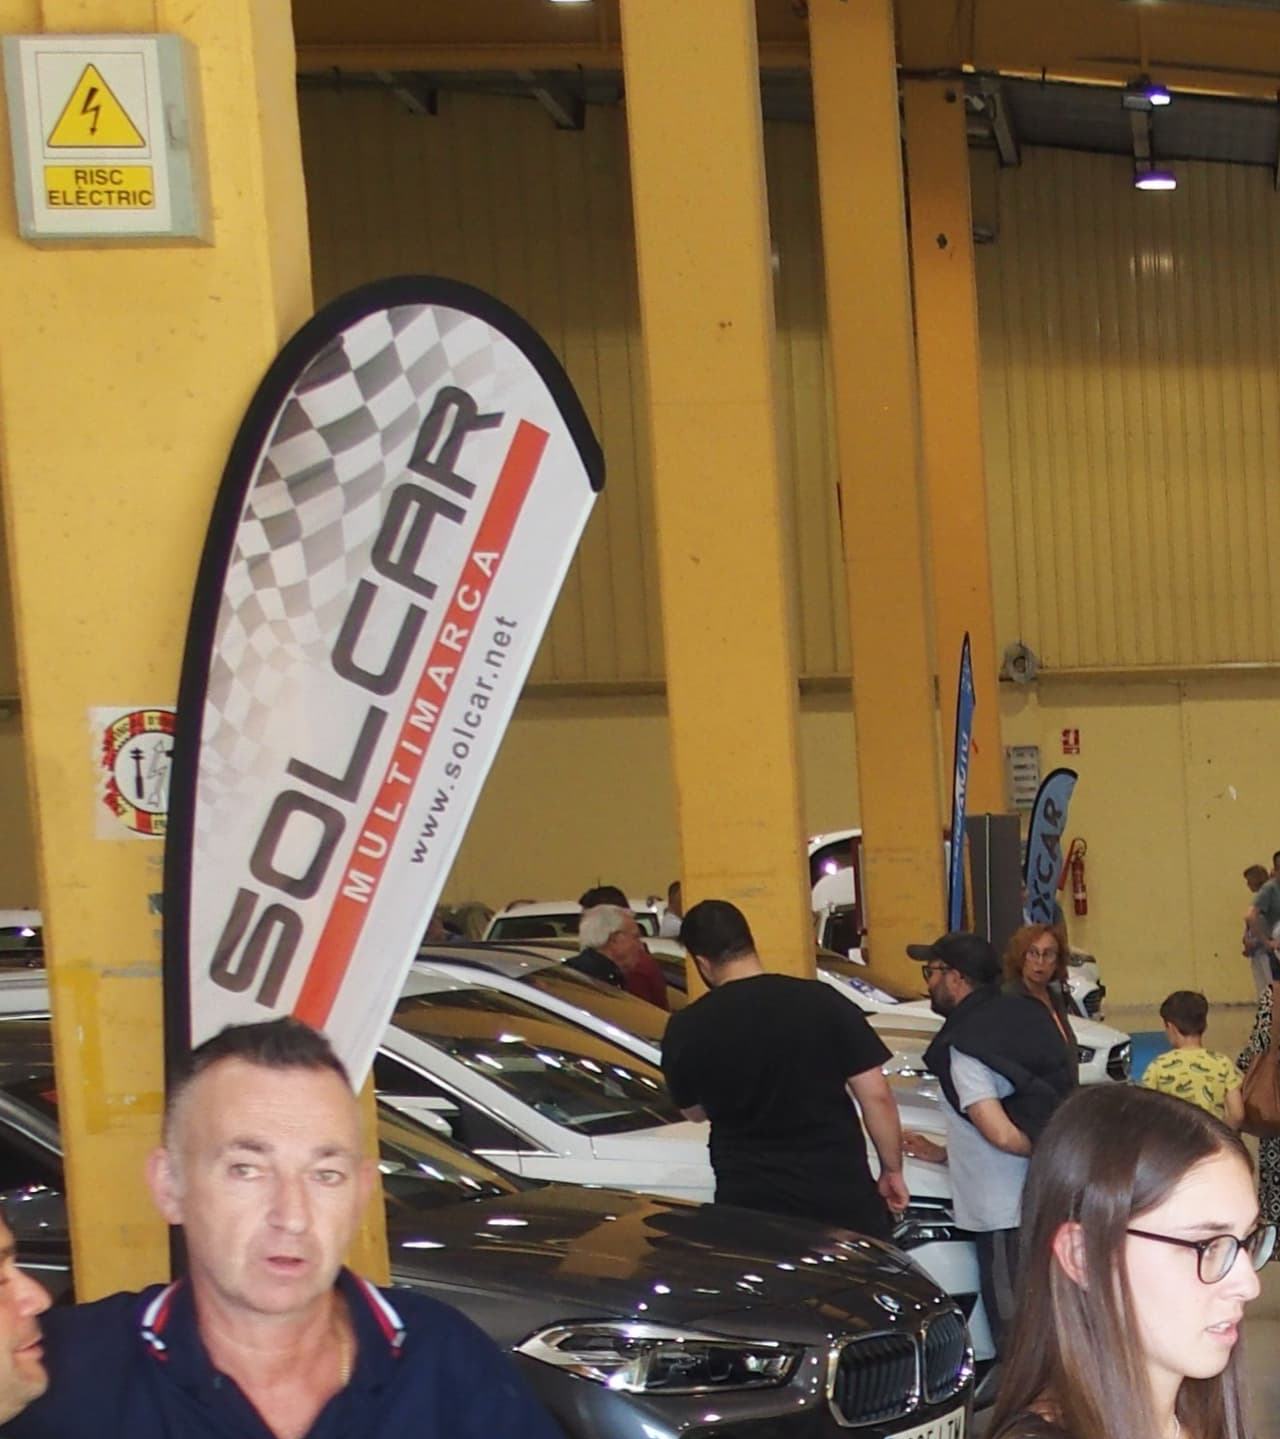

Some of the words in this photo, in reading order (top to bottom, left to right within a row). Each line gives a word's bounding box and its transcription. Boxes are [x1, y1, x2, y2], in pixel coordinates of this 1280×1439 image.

[47, 186, 153, 206] ELÈCTRIC
[74, 168, 123, 186] RISC
[207, 385, 506, 1010] SOLCAR
[342, 548, 500, 904] MULTIMARCA
[409, 614, 519, 866] www.solcar.net
